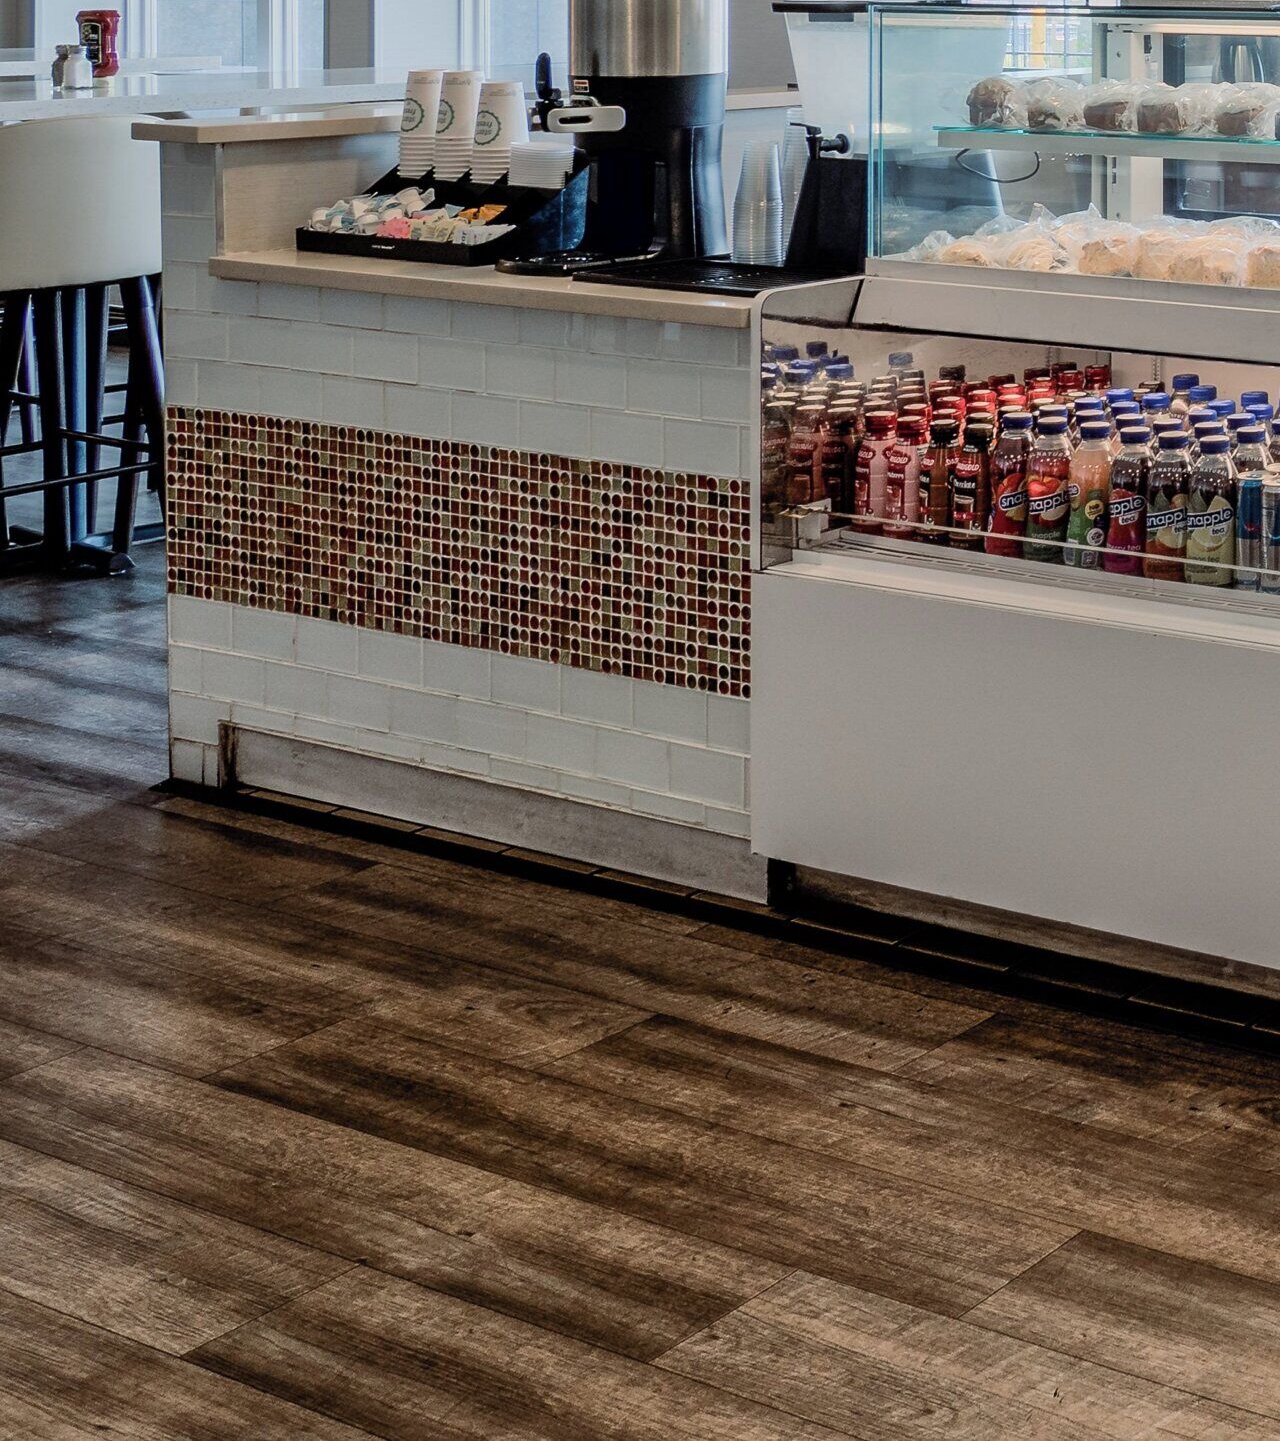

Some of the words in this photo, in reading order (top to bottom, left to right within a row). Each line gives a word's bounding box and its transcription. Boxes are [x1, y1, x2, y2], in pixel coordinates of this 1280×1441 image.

[1029, 493, 1069, 512] napple
[1109, 498, 1142, 514] apple
[1121, 515, 1136, 524] tea
[1146, 510, 1187, 527] snappl
[1211, 527, 1225, 536] tea
